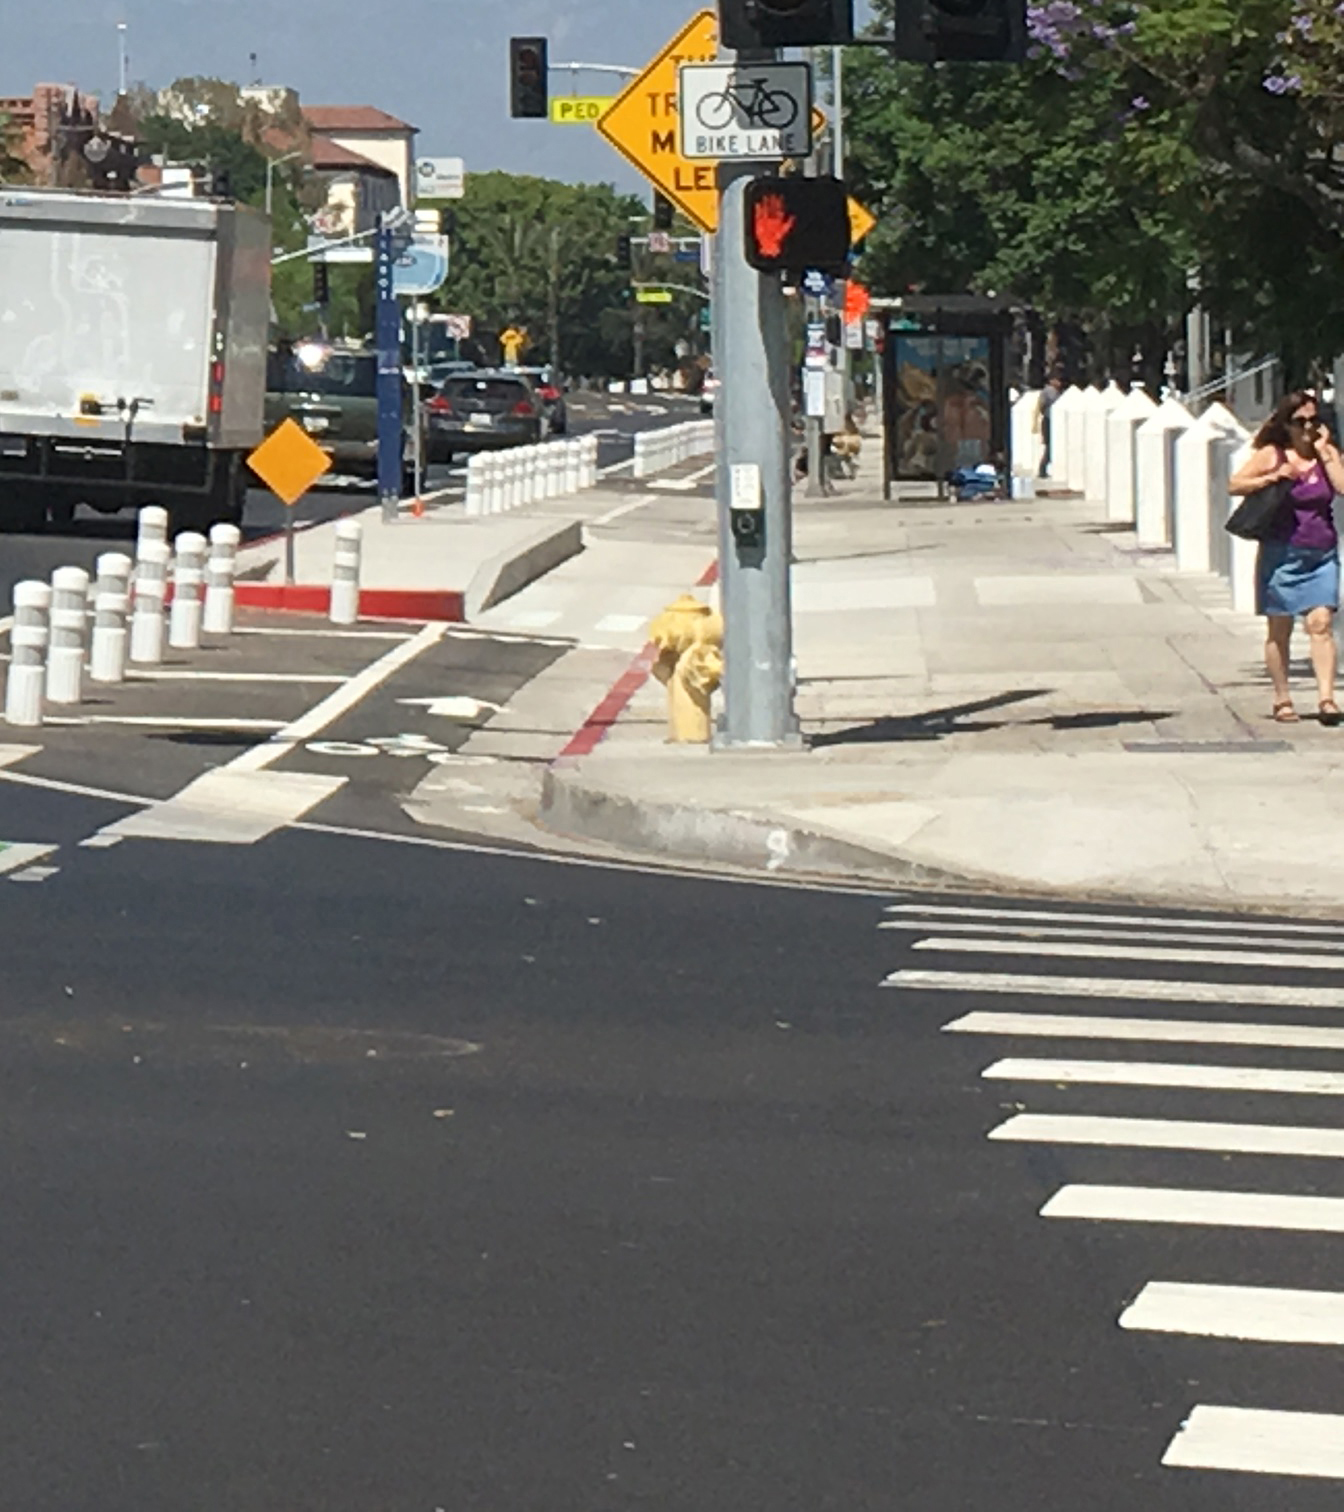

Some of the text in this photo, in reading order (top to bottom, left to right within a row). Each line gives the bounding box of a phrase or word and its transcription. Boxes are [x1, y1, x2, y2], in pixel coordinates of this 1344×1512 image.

[560, 102, 599, 120] PED
[695, 134, 738, 154] BIKE
[746, 133, 796, 153] LANE
